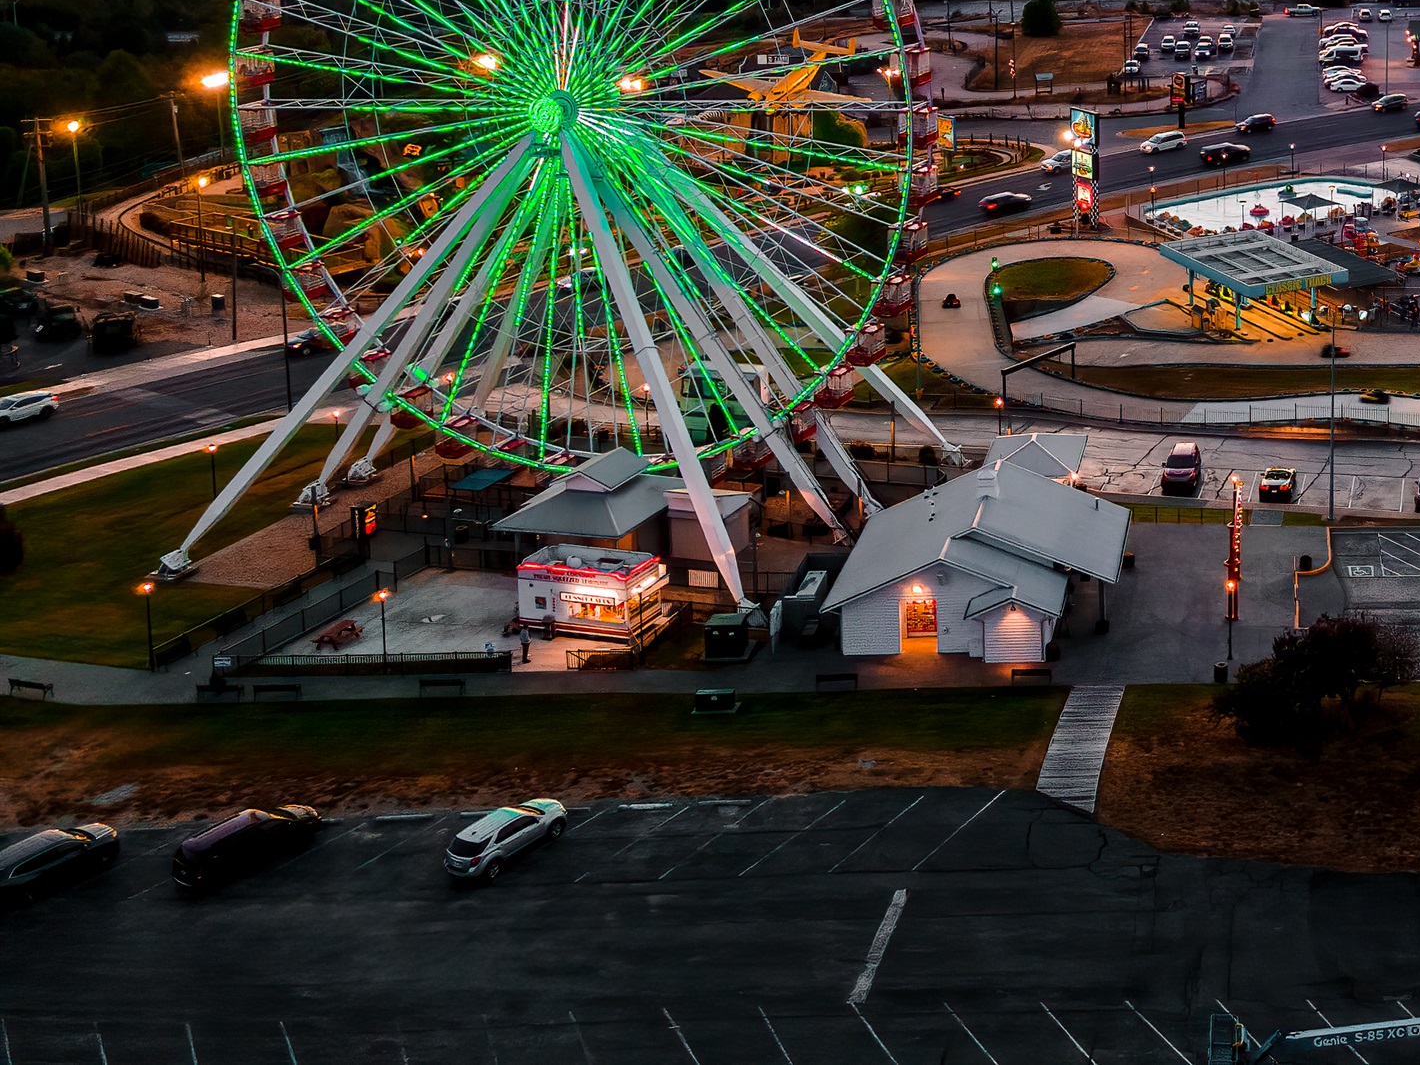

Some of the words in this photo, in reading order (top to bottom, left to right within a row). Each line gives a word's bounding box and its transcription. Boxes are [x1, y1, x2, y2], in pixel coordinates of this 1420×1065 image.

[1266, 279, 1302, 295] CLASSIC
[1305, 275, 1332, 288] TRACK
[1313, 1036, 1348, 1048] Genie
[1354, 1029, 1384, 1043] S-85
[1386, 1027, 1406, 1040] XC
